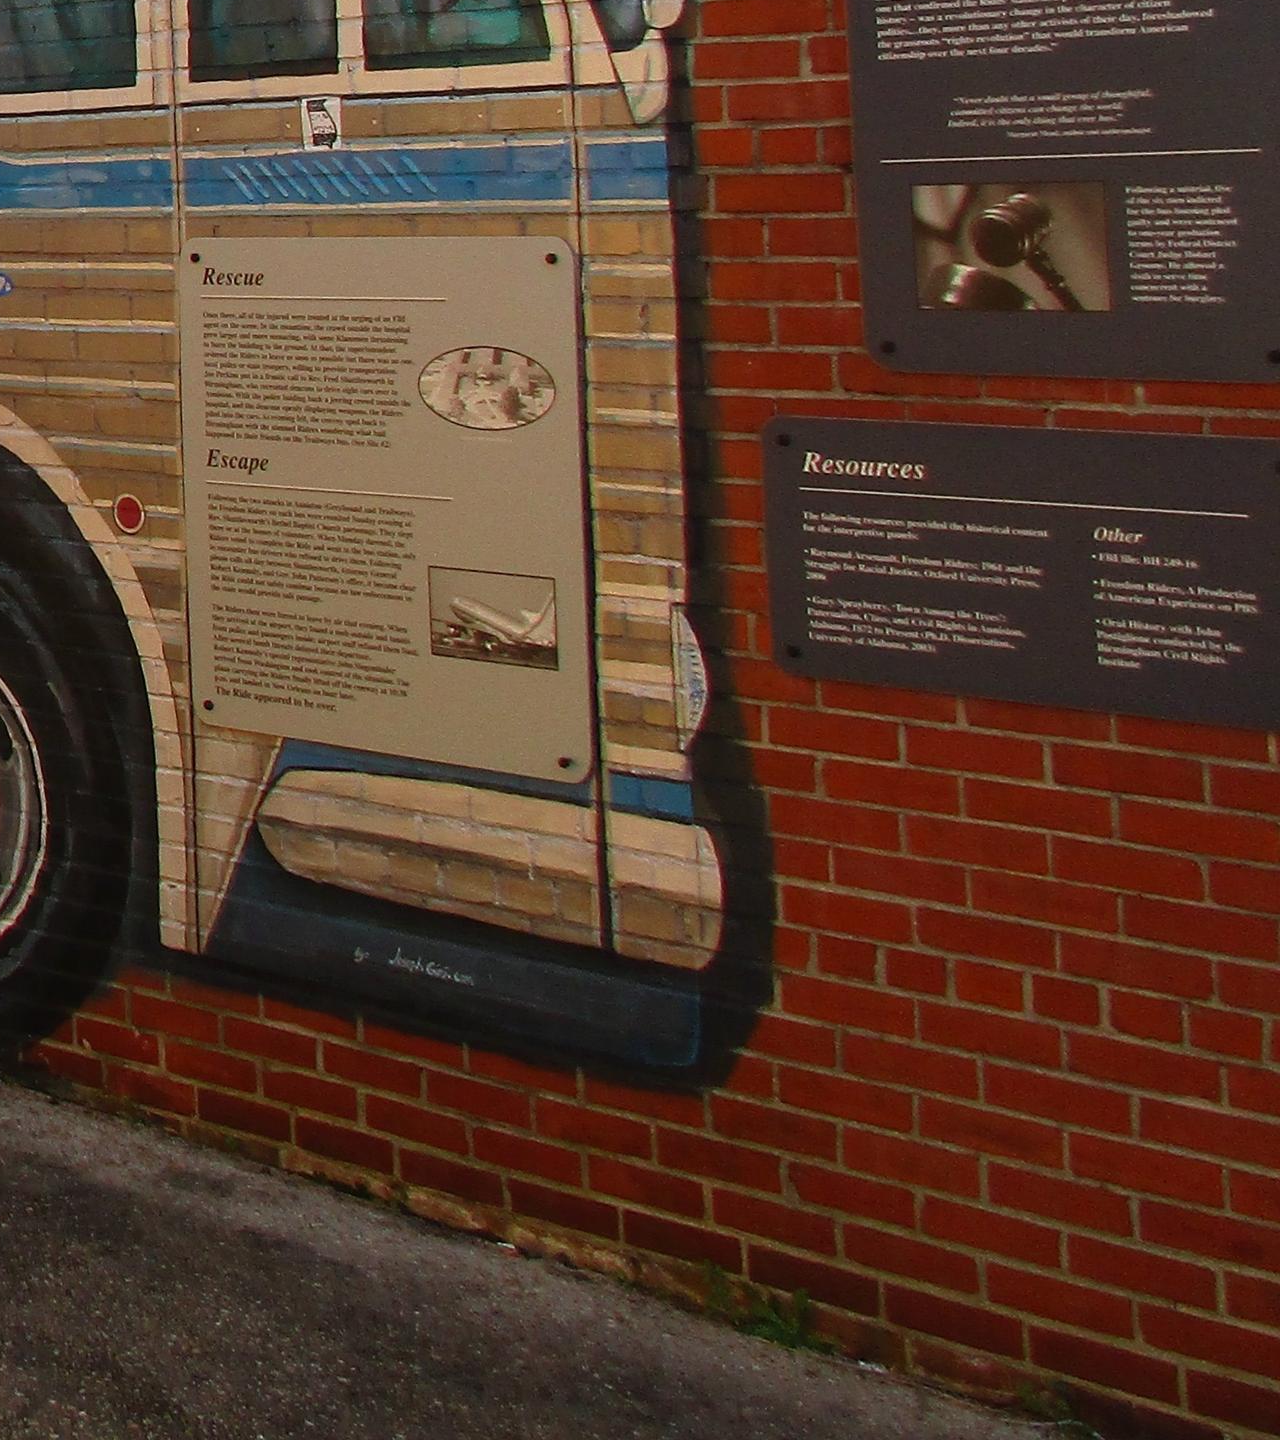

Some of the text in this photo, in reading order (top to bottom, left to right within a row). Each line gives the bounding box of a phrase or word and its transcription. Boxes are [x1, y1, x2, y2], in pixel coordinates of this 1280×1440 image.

[201, 266, 265, 289] Rescue
[206, 447, 270, 474] Escape
[801, 450, 926, 481] Resources
[1093, 526, 1144, 546] Other
